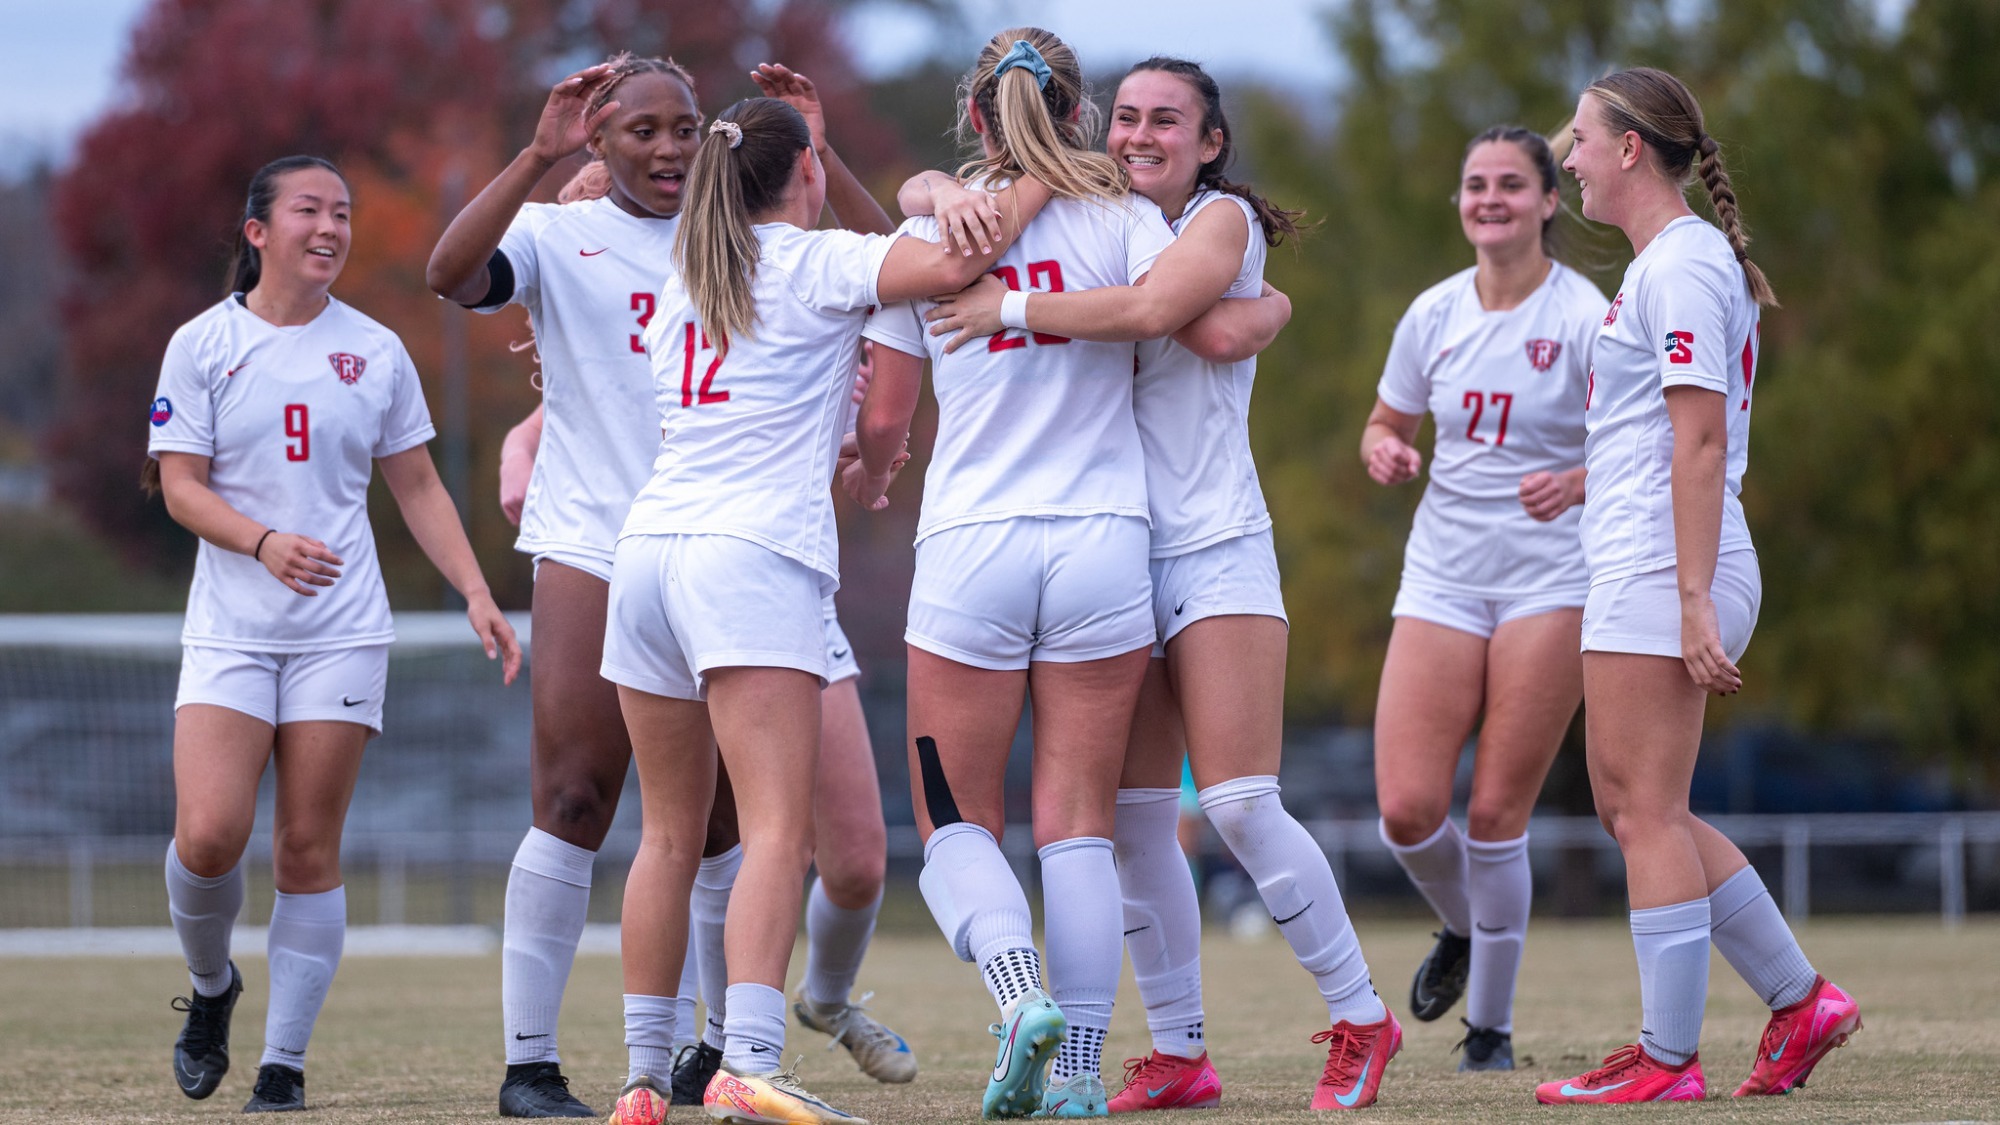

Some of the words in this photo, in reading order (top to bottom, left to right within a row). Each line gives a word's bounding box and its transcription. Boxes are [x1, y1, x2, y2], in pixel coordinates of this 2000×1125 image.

[340, 354, 357, 380] R
[682, 321, 730, 408] 12
[285, 404, 310, 462] 9
[1463, 391, 1513, 446] 27
